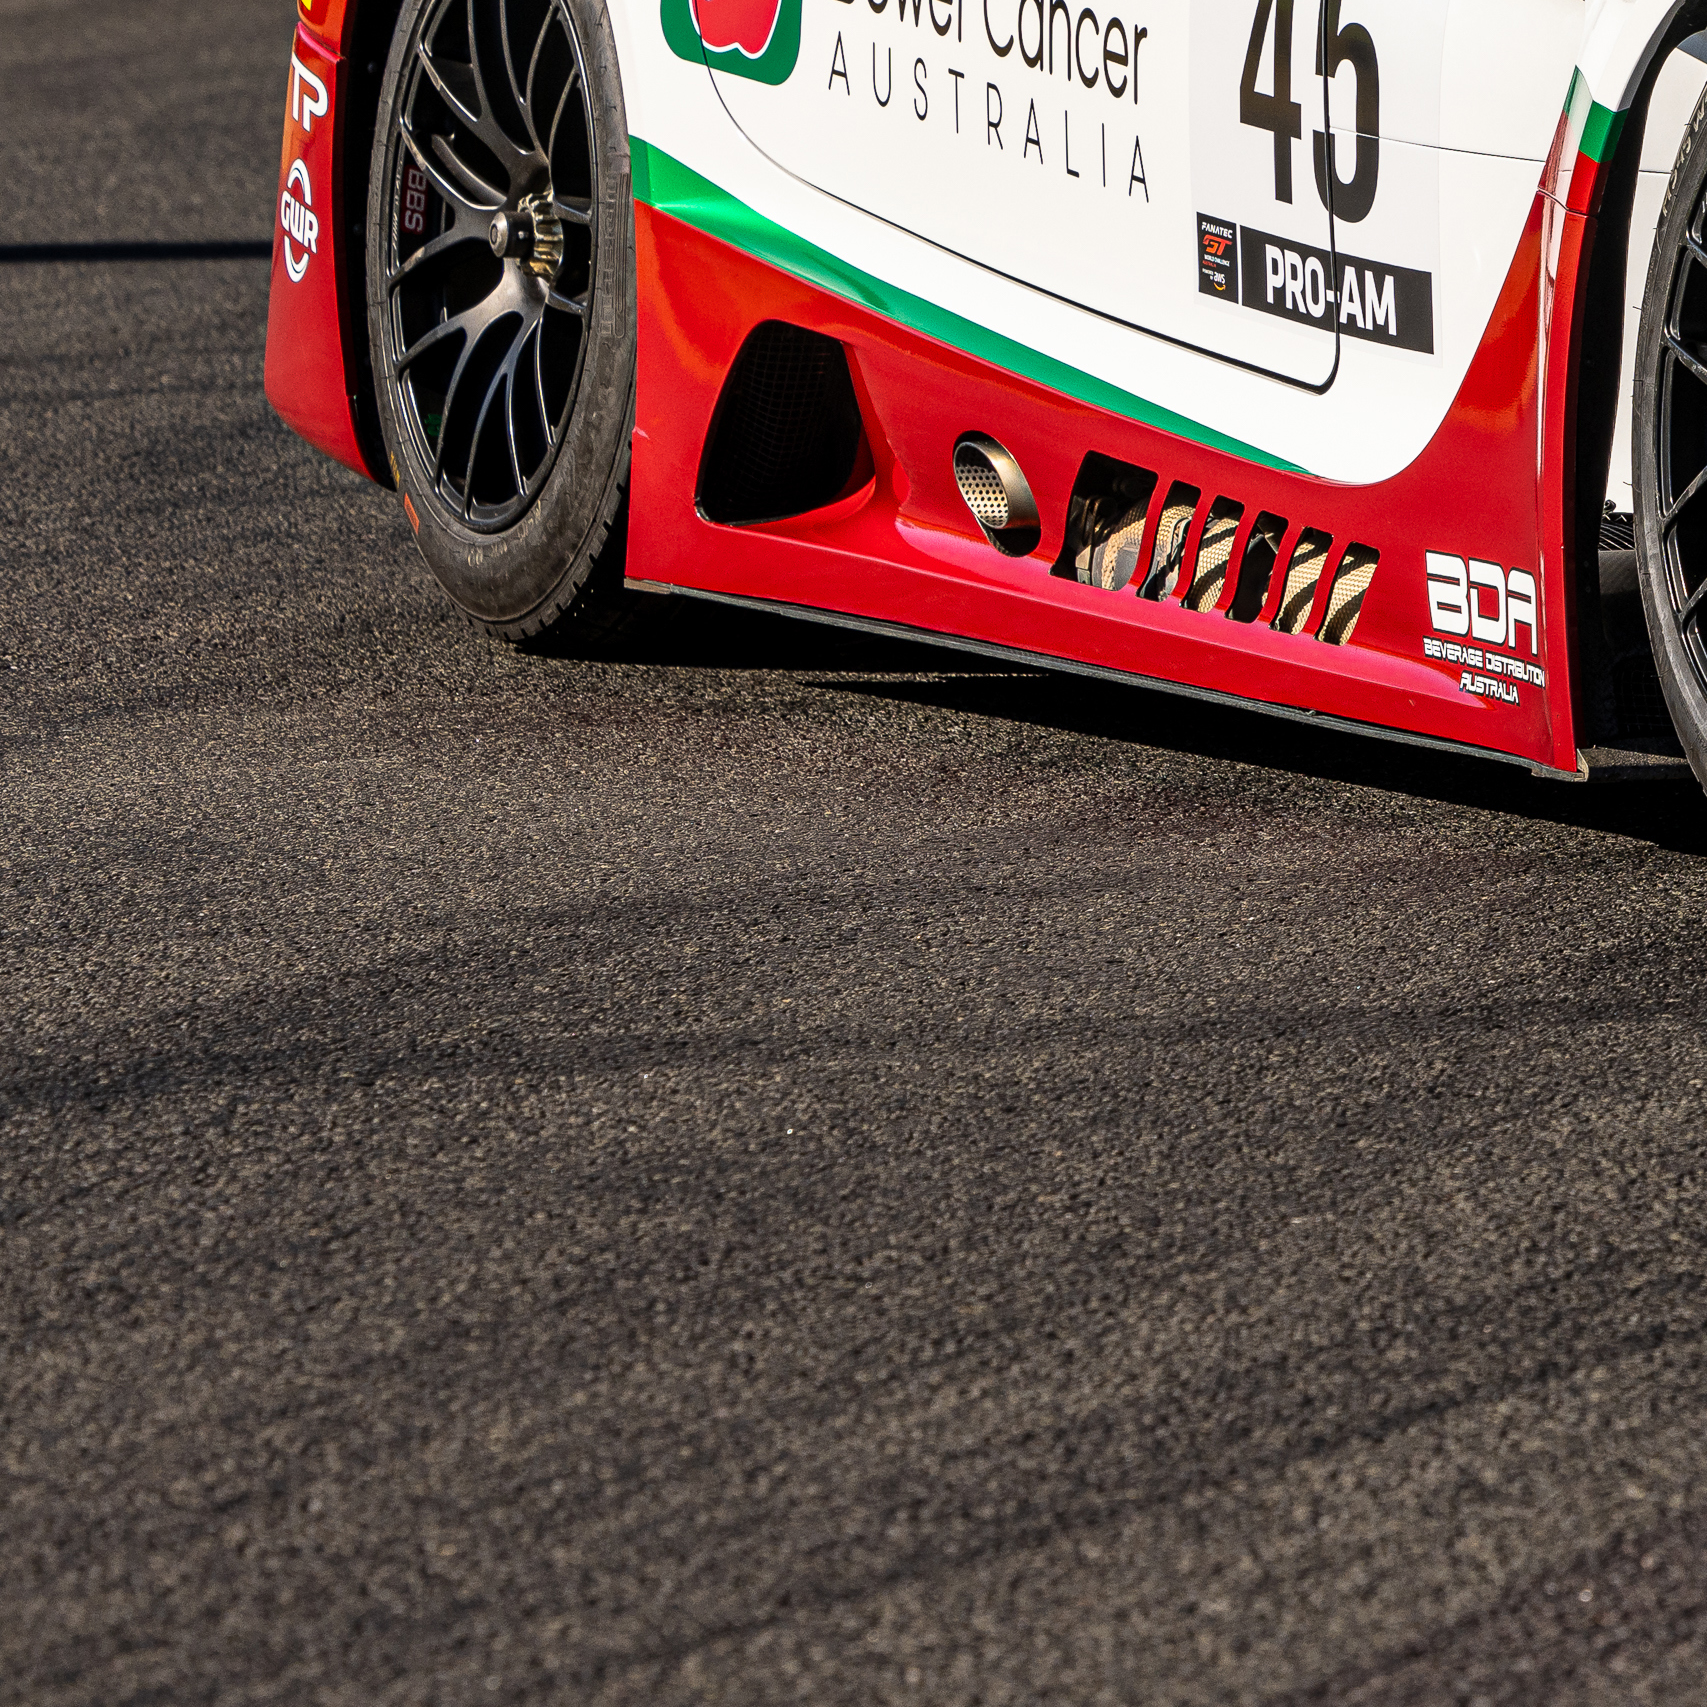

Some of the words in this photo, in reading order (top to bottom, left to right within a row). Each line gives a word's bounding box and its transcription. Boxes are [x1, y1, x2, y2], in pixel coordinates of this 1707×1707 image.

[828, 31, 1149, 203] AUSTRALIA
[280, 189, 320, 254] GWR
[404, 168, 428, 232] BBS
[1201, 221, 1233, 239] FANATEC
[1202, 234, 1233, 256] GT
[1265, 243, 1398, 337] PRO-AM
[1425, 549, 1538, 658] BDA
[1423, 635, 1484, 670] BEVERAGE
[1485, 650, 1546, 690] DISTRIBUTION
[1459, 669, 1520, 706] AUSTRALIA
